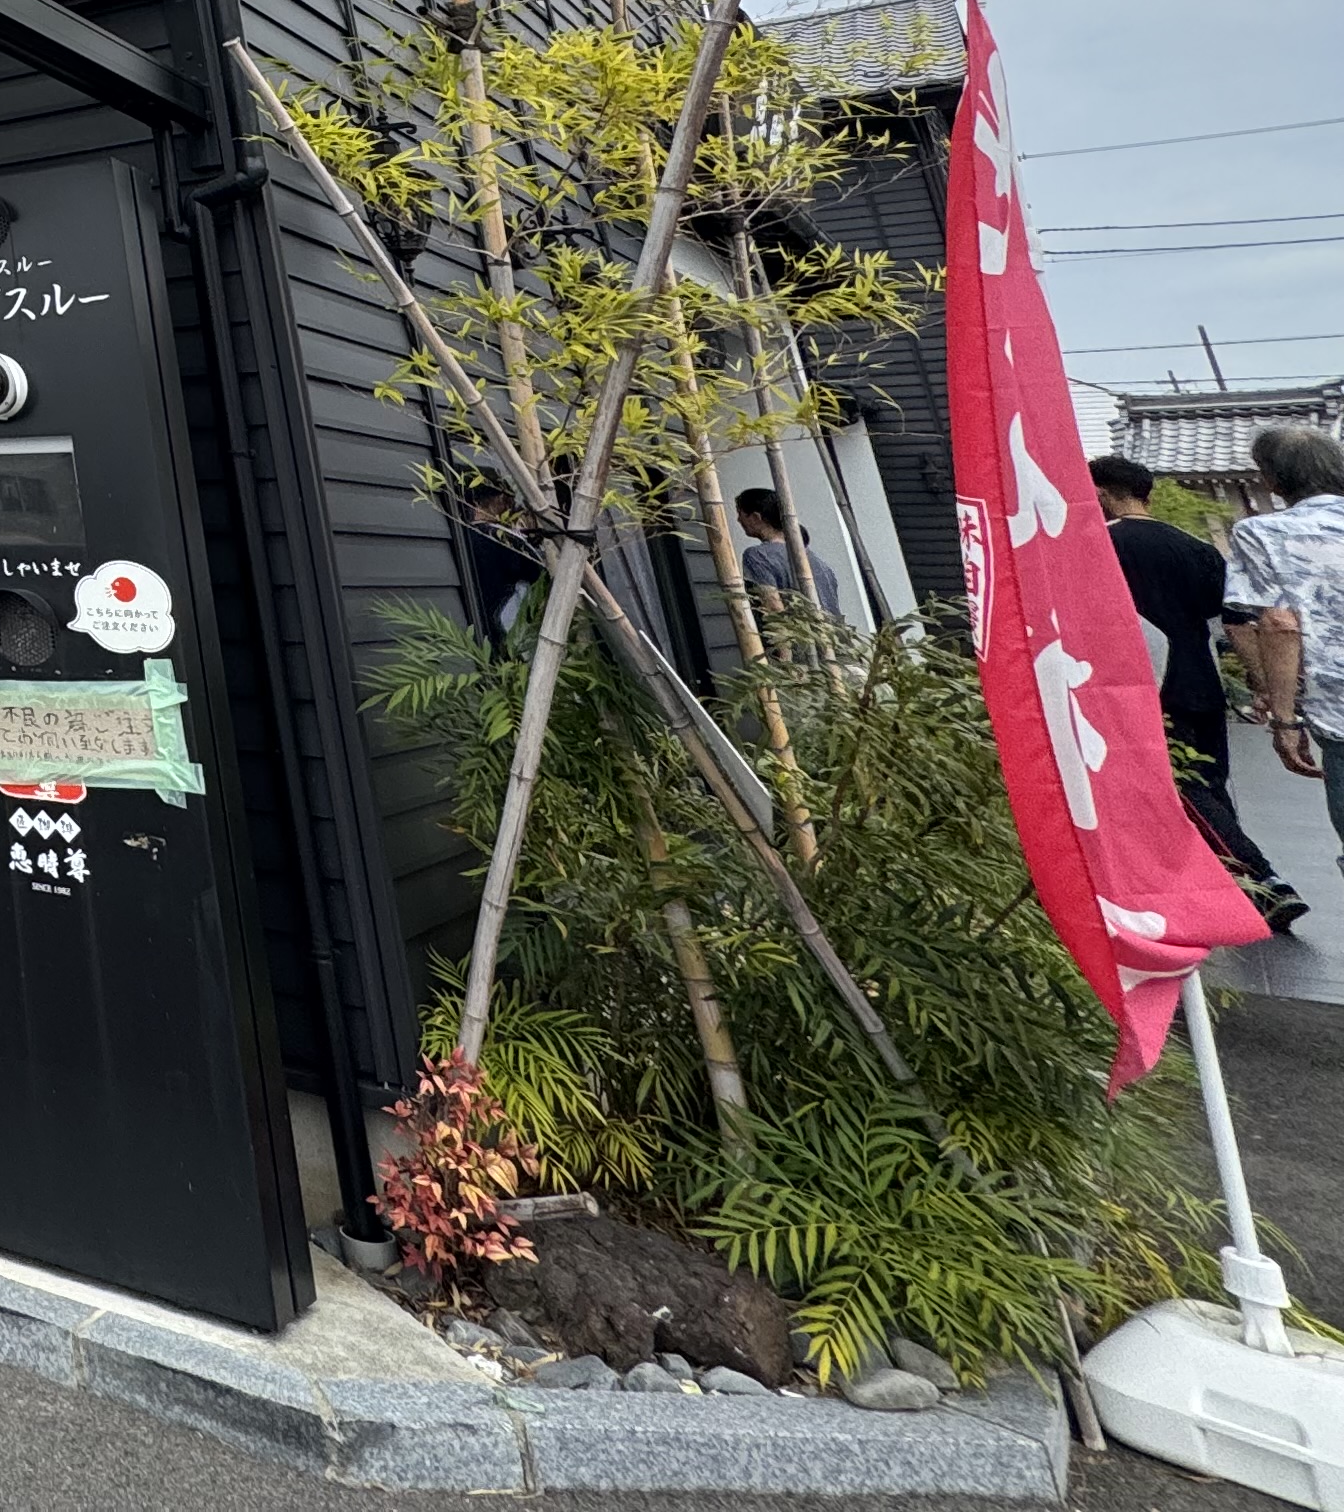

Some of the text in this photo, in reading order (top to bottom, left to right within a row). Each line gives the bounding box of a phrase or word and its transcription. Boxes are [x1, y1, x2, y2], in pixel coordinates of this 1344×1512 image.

[87, 607, 158, 619] こちらに向かって
[92, 621, 159, 632] ご注文ください
